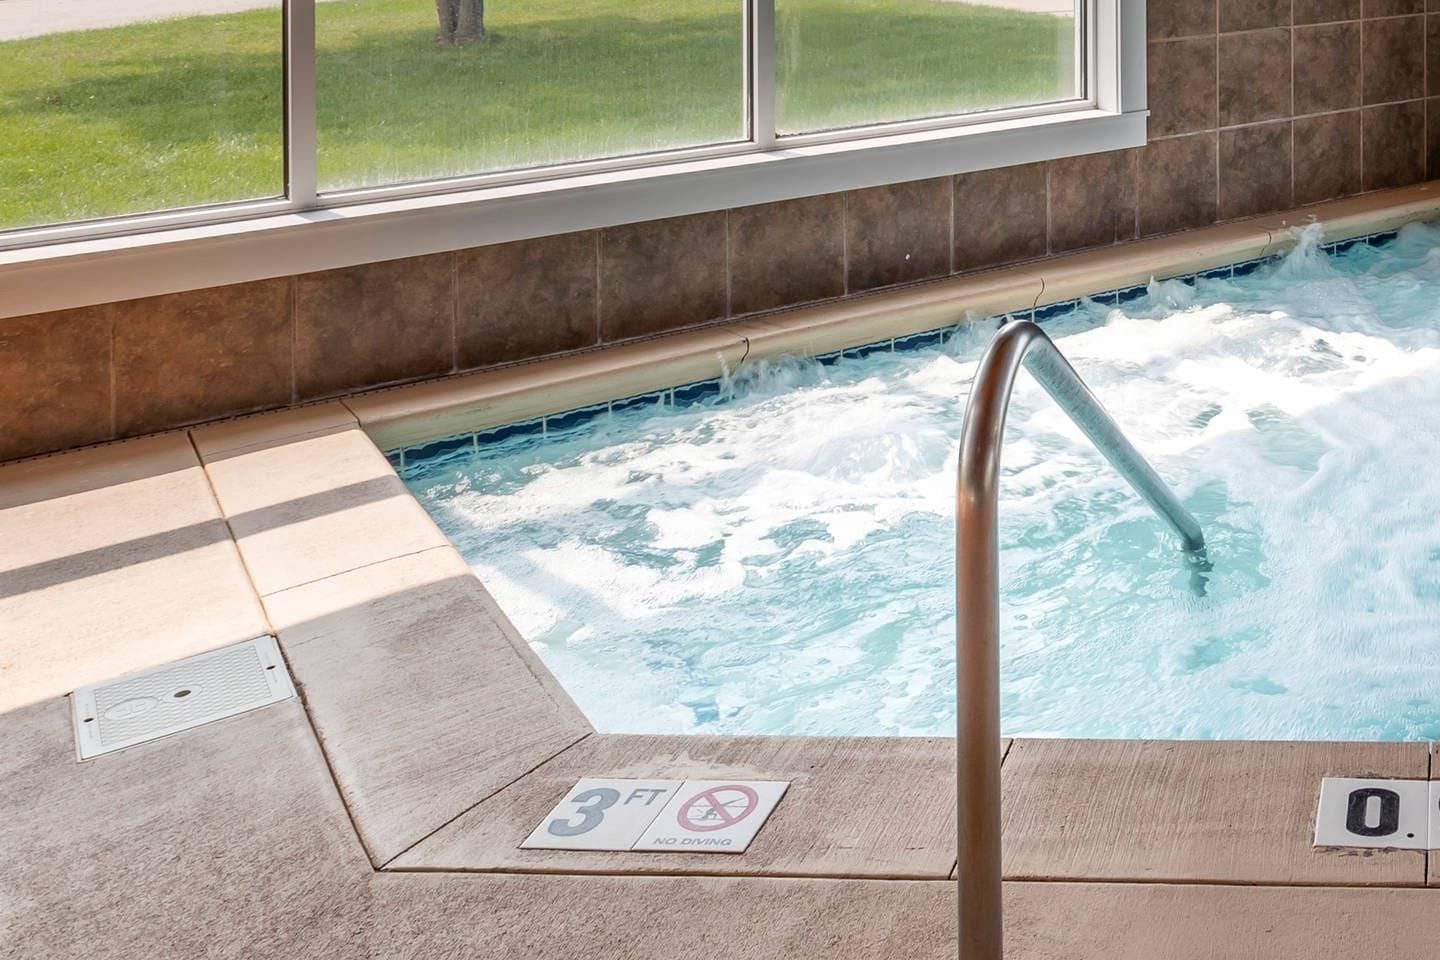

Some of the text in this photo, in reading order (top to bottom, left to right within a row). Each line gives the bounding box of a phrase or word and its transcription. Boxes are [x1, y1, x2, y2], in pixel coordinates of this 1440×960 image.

[547, 787, 668, 837] 3 FT
[654, 837, 733, 847] NO DIVING
